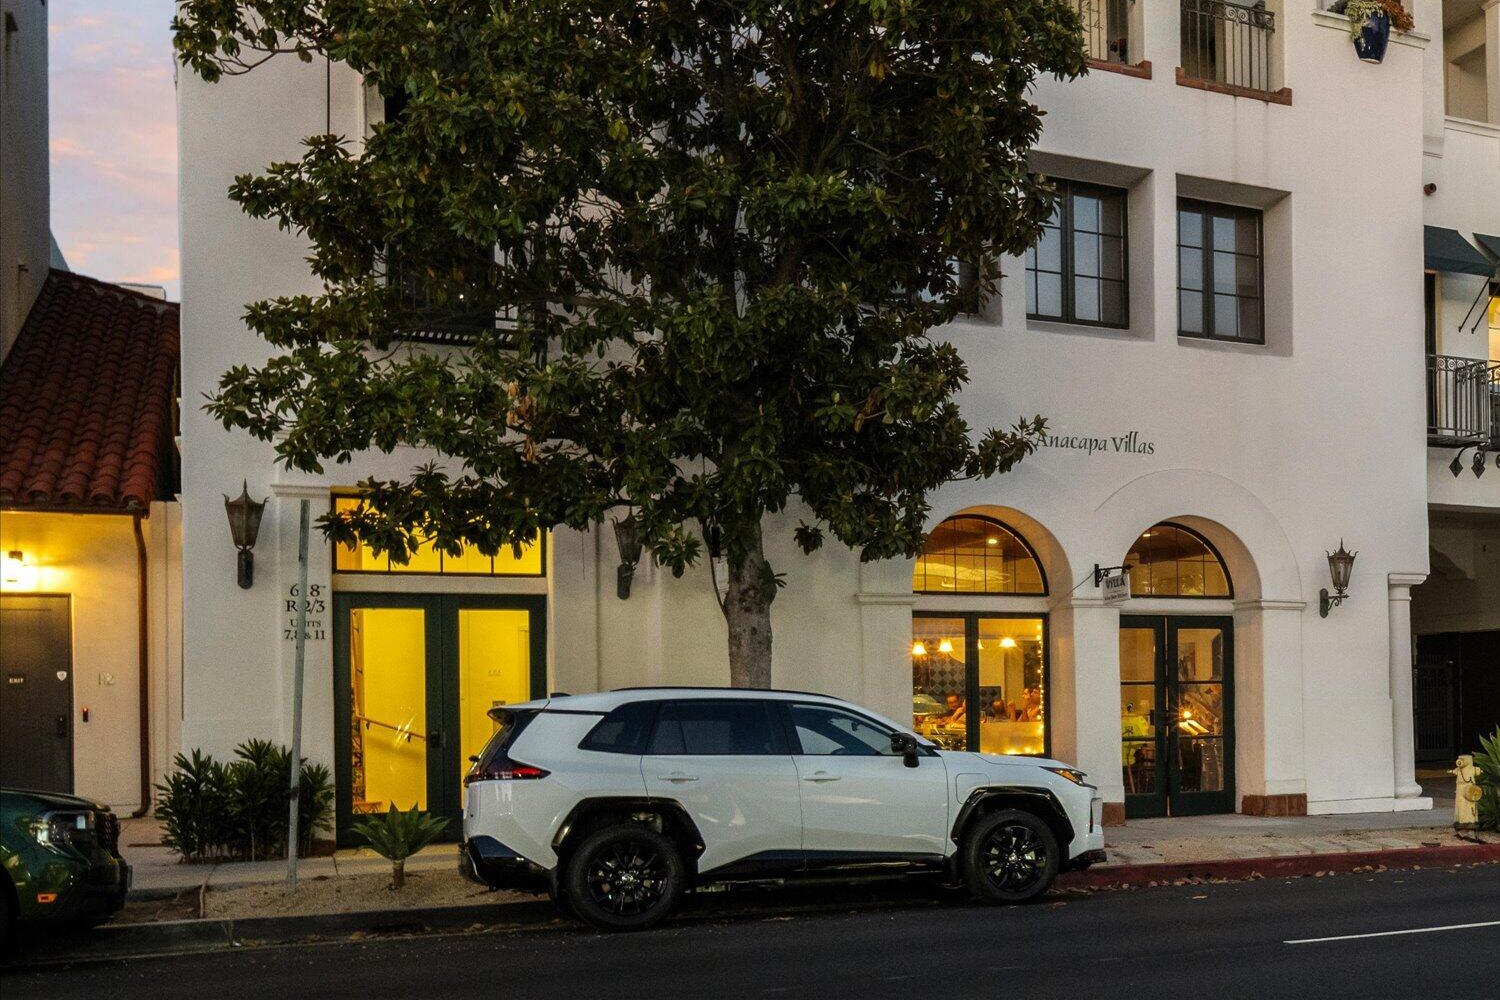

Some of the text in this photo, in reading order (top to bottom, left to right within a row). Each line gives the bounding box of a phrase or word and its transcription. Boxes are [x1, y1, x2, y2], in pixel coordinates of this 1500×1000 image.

[1110, 430, 1155, 454] Villas
[1105, 577, 1126, 589] VILLA
[290, 583, 320, 598] 68
[315, 630, 326, 640] 11
